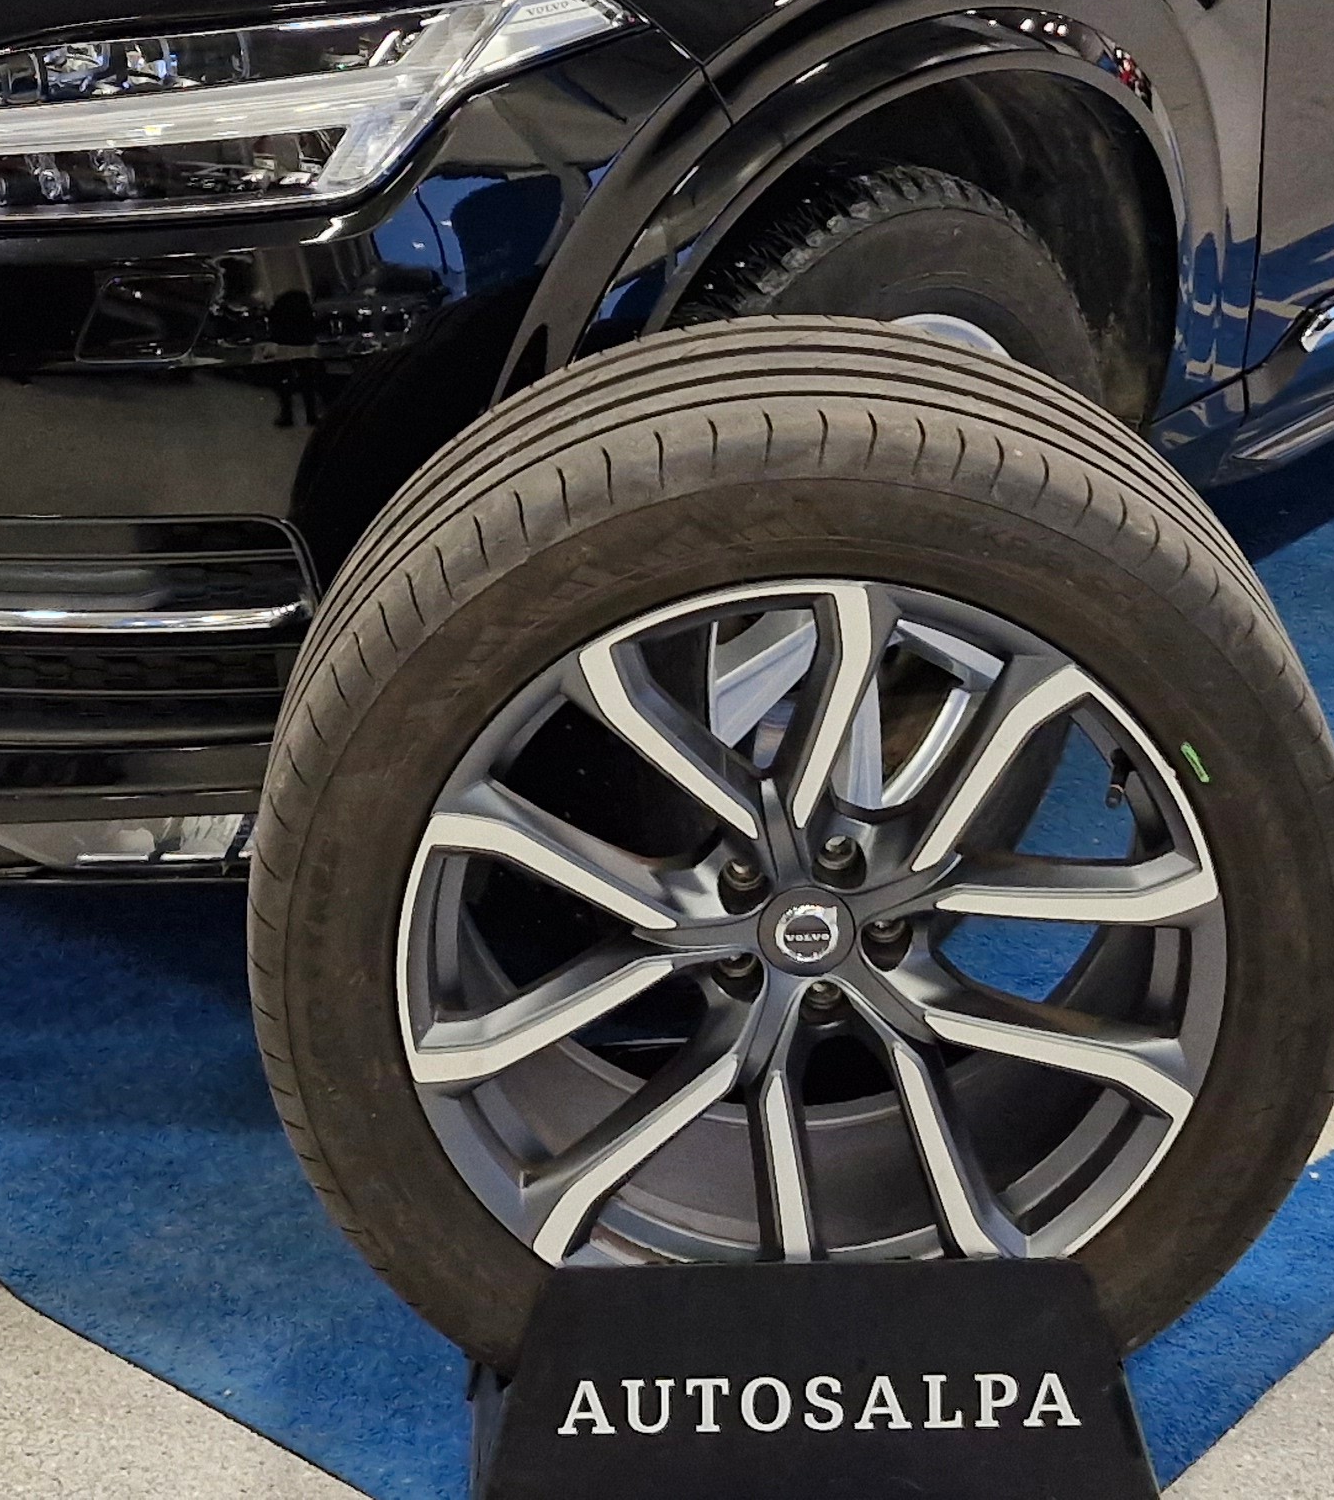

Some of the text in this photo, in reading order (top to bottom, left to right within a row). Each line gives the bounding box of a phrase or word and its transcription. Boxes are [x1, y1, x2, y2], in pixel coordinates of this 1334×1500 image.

[526, 0, 570, 16] VOLVO
[785, 933, 830, 942] VOLVO
[556, 1372, 1083, 1437] AUTOSALPA
